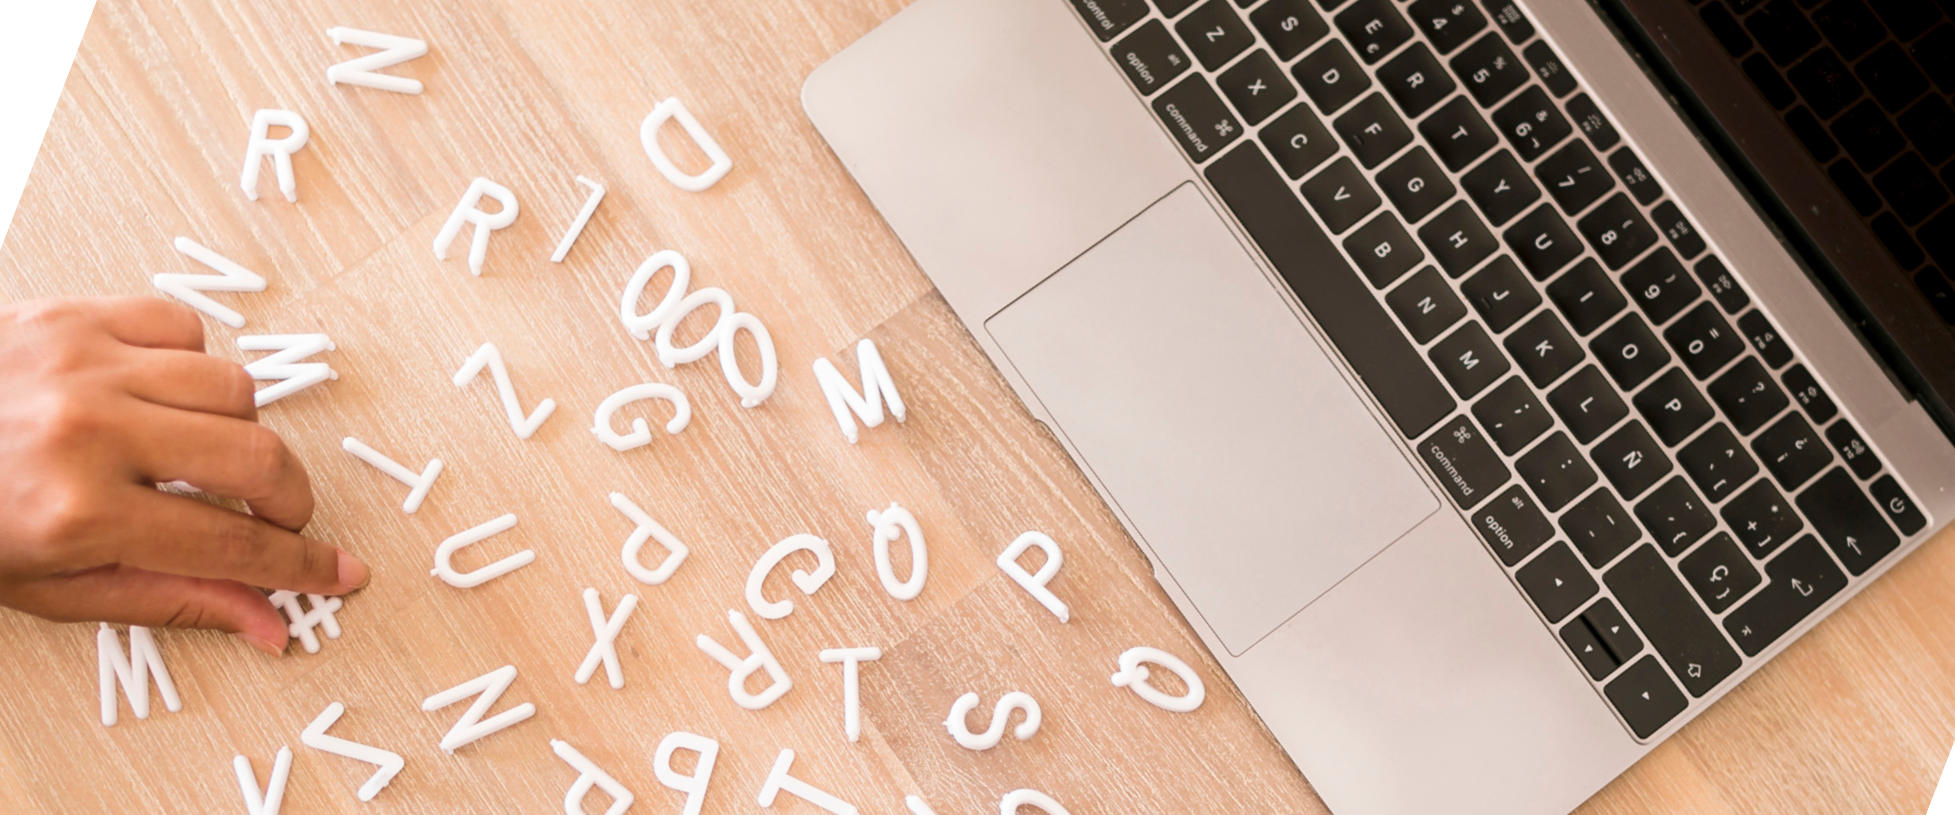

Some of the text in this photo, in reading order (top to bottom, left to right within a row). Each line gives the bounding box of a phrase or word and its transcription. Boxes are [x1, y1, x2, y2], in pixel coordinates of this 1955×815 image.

[1280, 16, 1299, 32] S
[1364, 18, 1383, 35] E
[1432, 18, 1448, 30] 4
[1205, 26, 1225, 42] Z
[1126, 53, 1154, 84] option
[1167, 53, 1181, 66] alt
[1322, 68, 1340, 85] D
[1406, 71, 1425, 89] R
[1473, 68, 1490, 84] 5
[1247, 78, 1267, 96] X
[1165, 104, 1208, 152] command
[1364, 122, 1382, 135] F
[1451, 125, 1468, 140] T
[1515, 122, 1533, 137] 6
[639, 96, 732, 191] D
[1290, 133, 1308, 149] C
[240, 108, 309, 202] R
[1407, 177, 1425, 193] G
[1494, 178, 1511, 194] Y
[1558, 175, 1576, 188] 7
[1333, 186, 1351, 201] V
[433, 176, 519, 276] R
[1449, 230, 1468, 249] H
[1534, 232, 1553, 250] U
[1601, 229, 1618, 245] 8
[1374, 241, 1392, 258] B
[1492, 290, 1510, 301] J
[1644, 284, 1661, 300] 9
[1417, 296, 1437, 315] N
[1535, 339, 1554, 357] K
[1459, 350, 1480, 370] M
[812, 338, 906, 444] M
[1580, 396, 1594, 413] L
[1664, 398, 1682, 412] P
[590, 382, 691, 450] G
[1622, 450, 1643, 469] Ñ
[341, 437, 443, 514] T
[1431, 446, 1474, 497] command
[1511, 496, 1525, 510] alt
[609, 491, 688, 585] P
[1485, 515, 1514, 549] option
[431, 513, 535, 588] U
[996, 530, 1070, 623] P
[1709, 564, 1729, 583] Ç
[574, 588, 638, 688] X
[696, 609, 793, 710] R
[818, 646, 882, 743] T
[943, 691, 1042, 751] S
